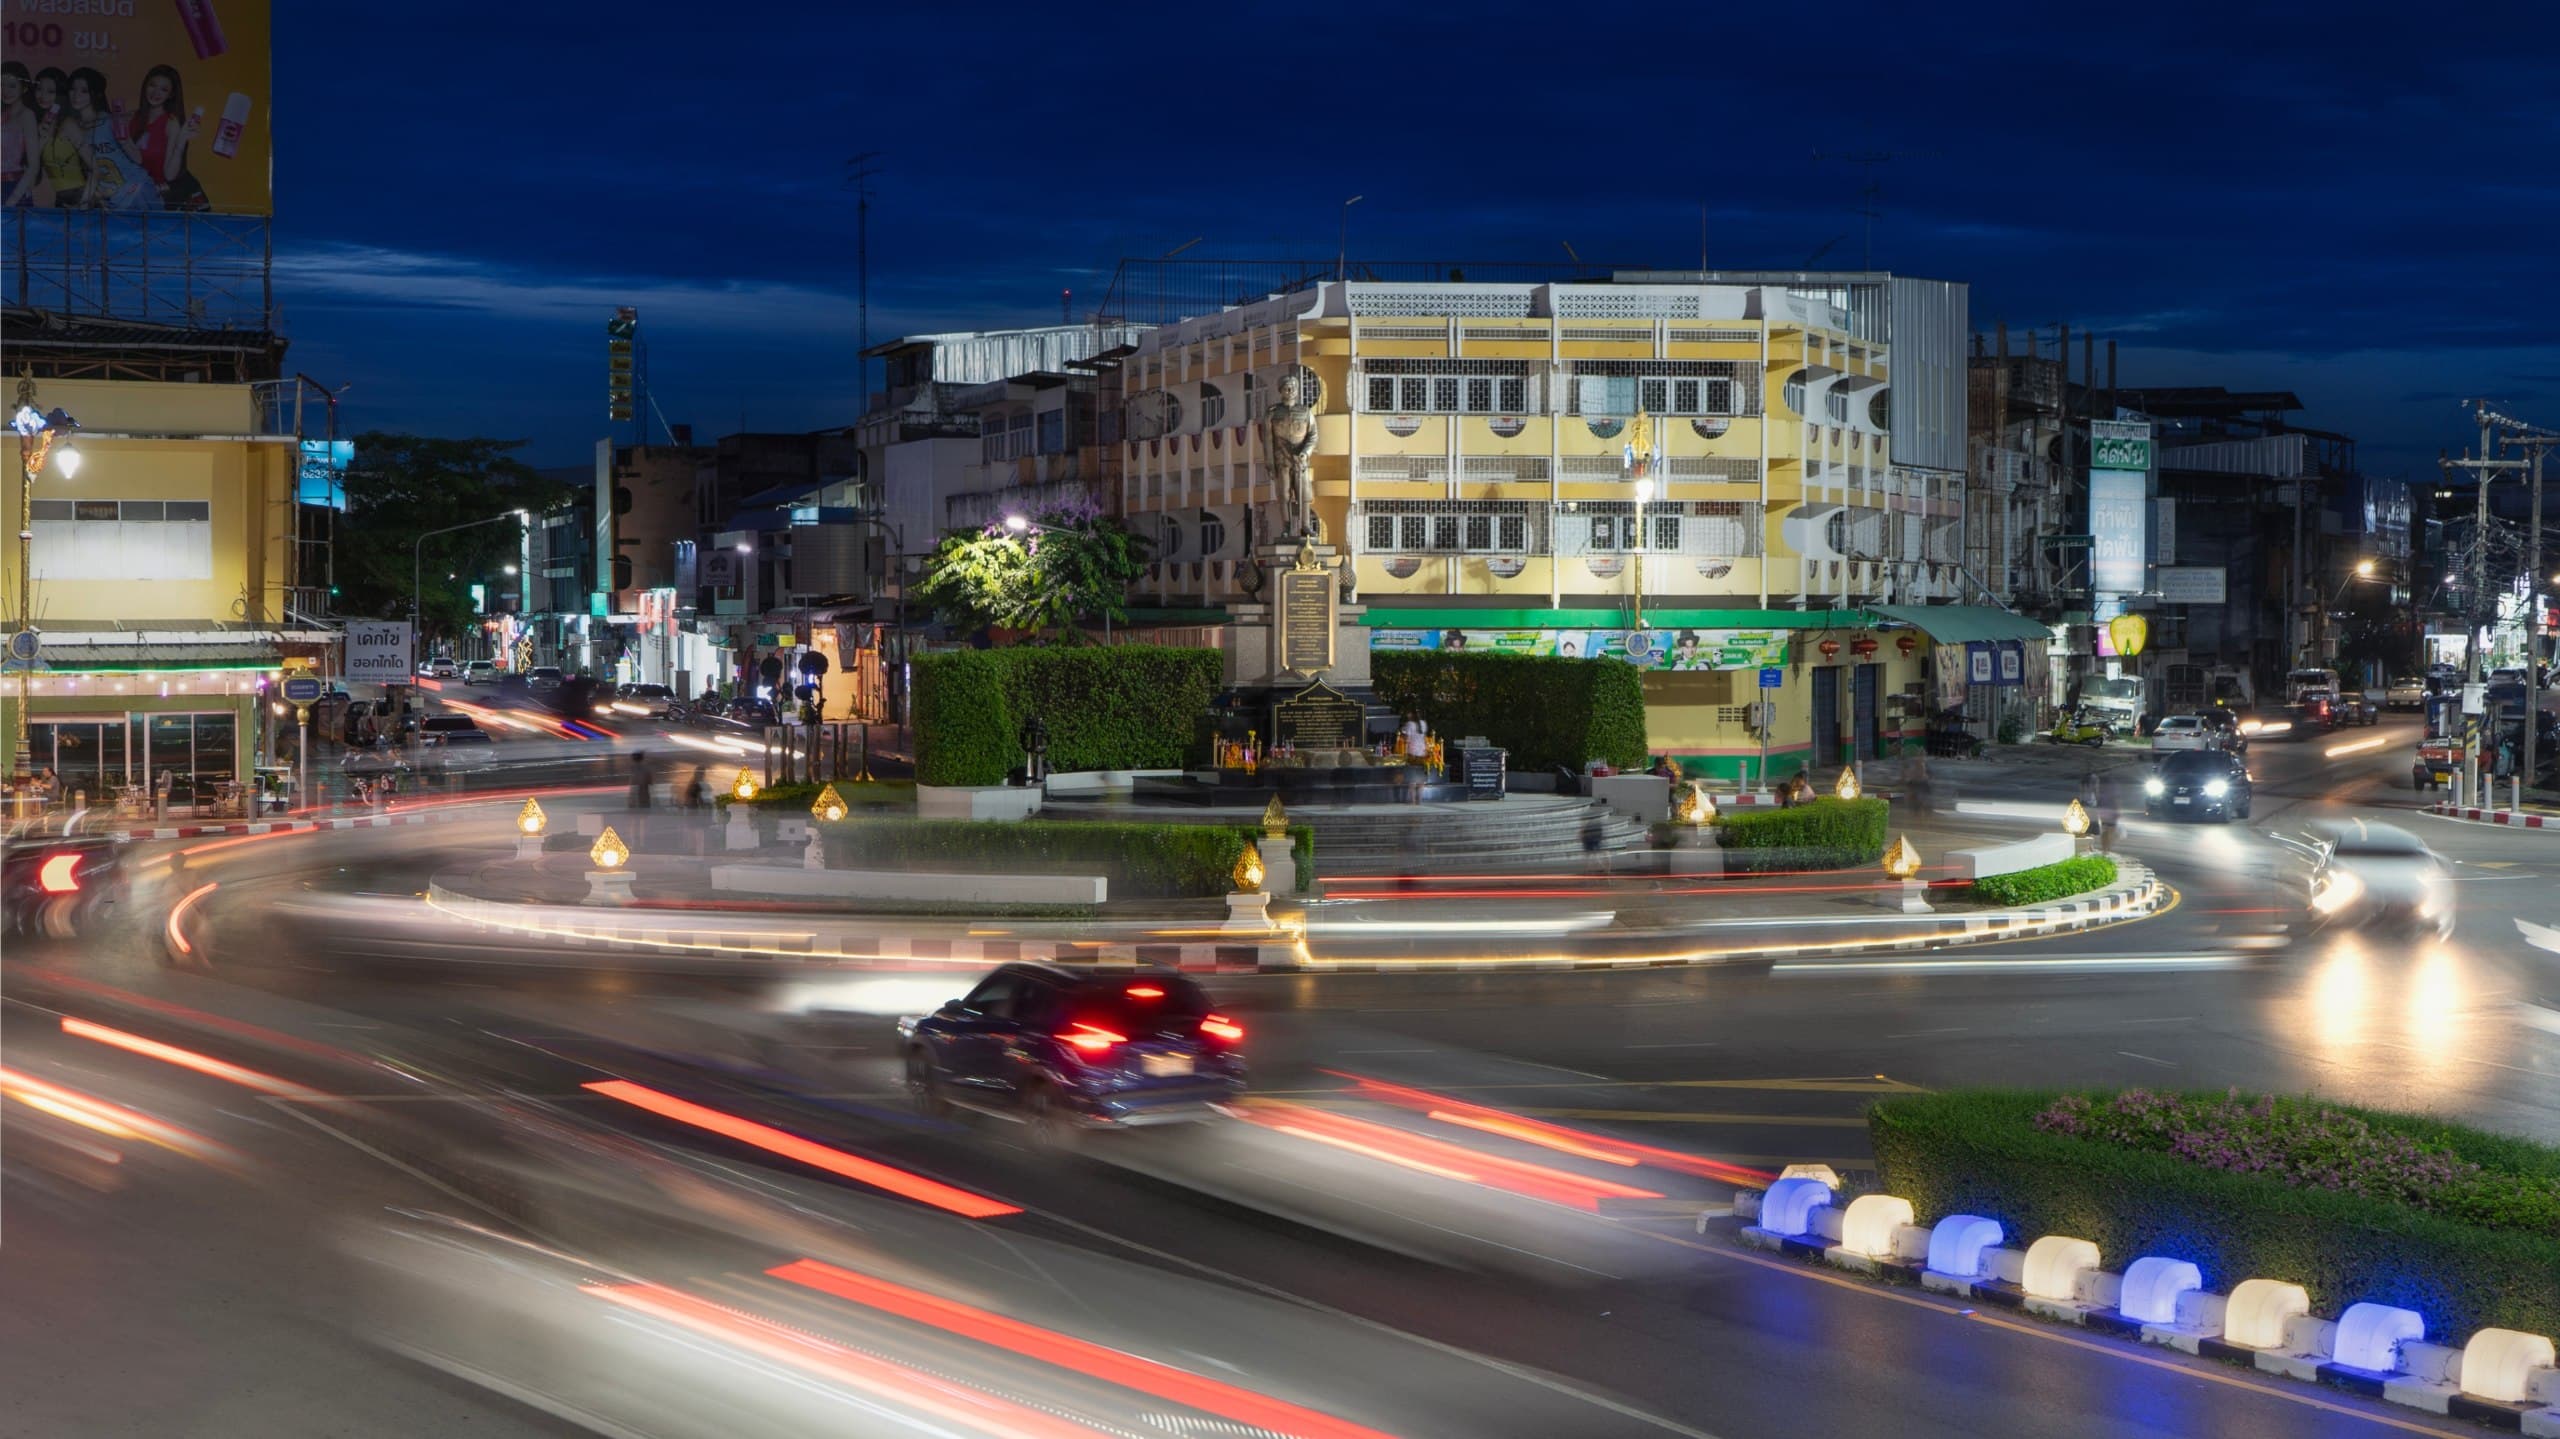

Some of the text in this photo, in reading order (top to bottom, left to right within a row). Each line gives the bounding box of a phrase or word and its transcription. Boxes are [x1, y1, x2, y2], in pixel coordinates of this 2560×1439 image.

[3, 21, 63, 48] 100
[357, 626, 400, 646] เค้กไข่
[353, 654, 404, 668] ฮอกไกโด
